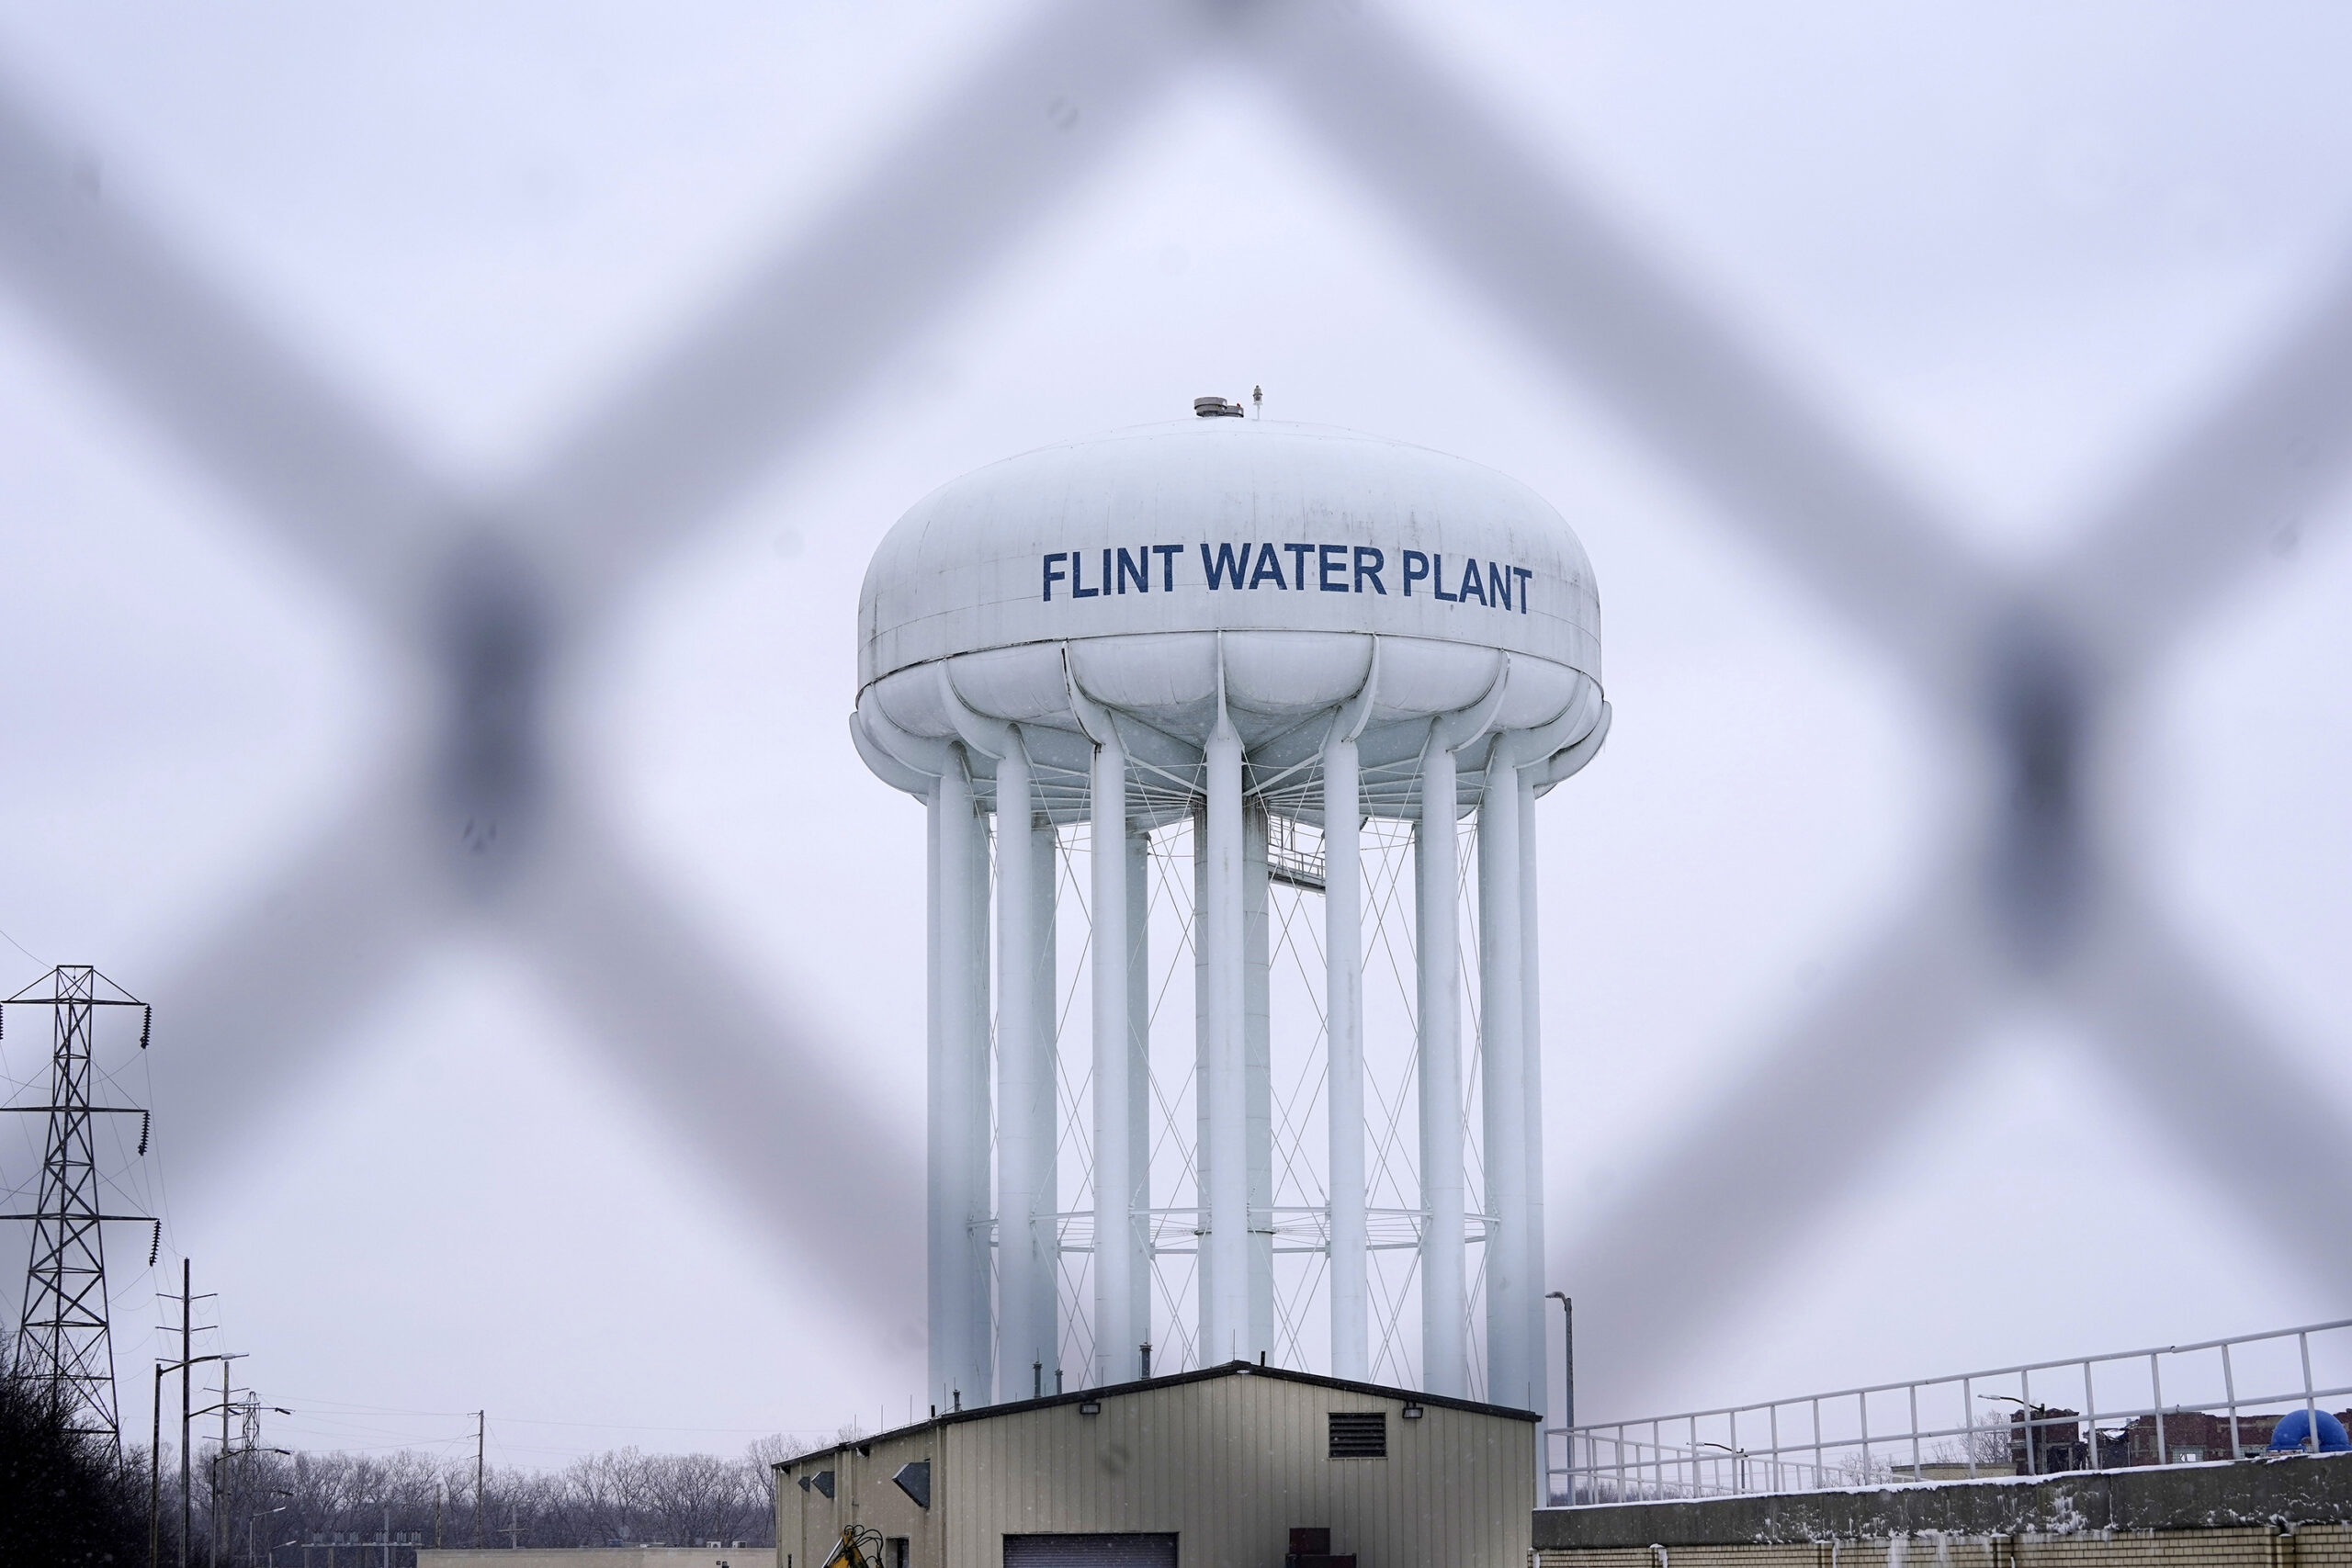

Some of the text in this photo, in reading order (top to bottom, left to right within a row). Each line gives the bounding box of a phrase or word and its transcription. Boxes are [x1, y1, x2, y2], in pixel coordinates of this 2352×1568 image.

[1043, 542, 1532, 615] FLINT WATER PLANT
